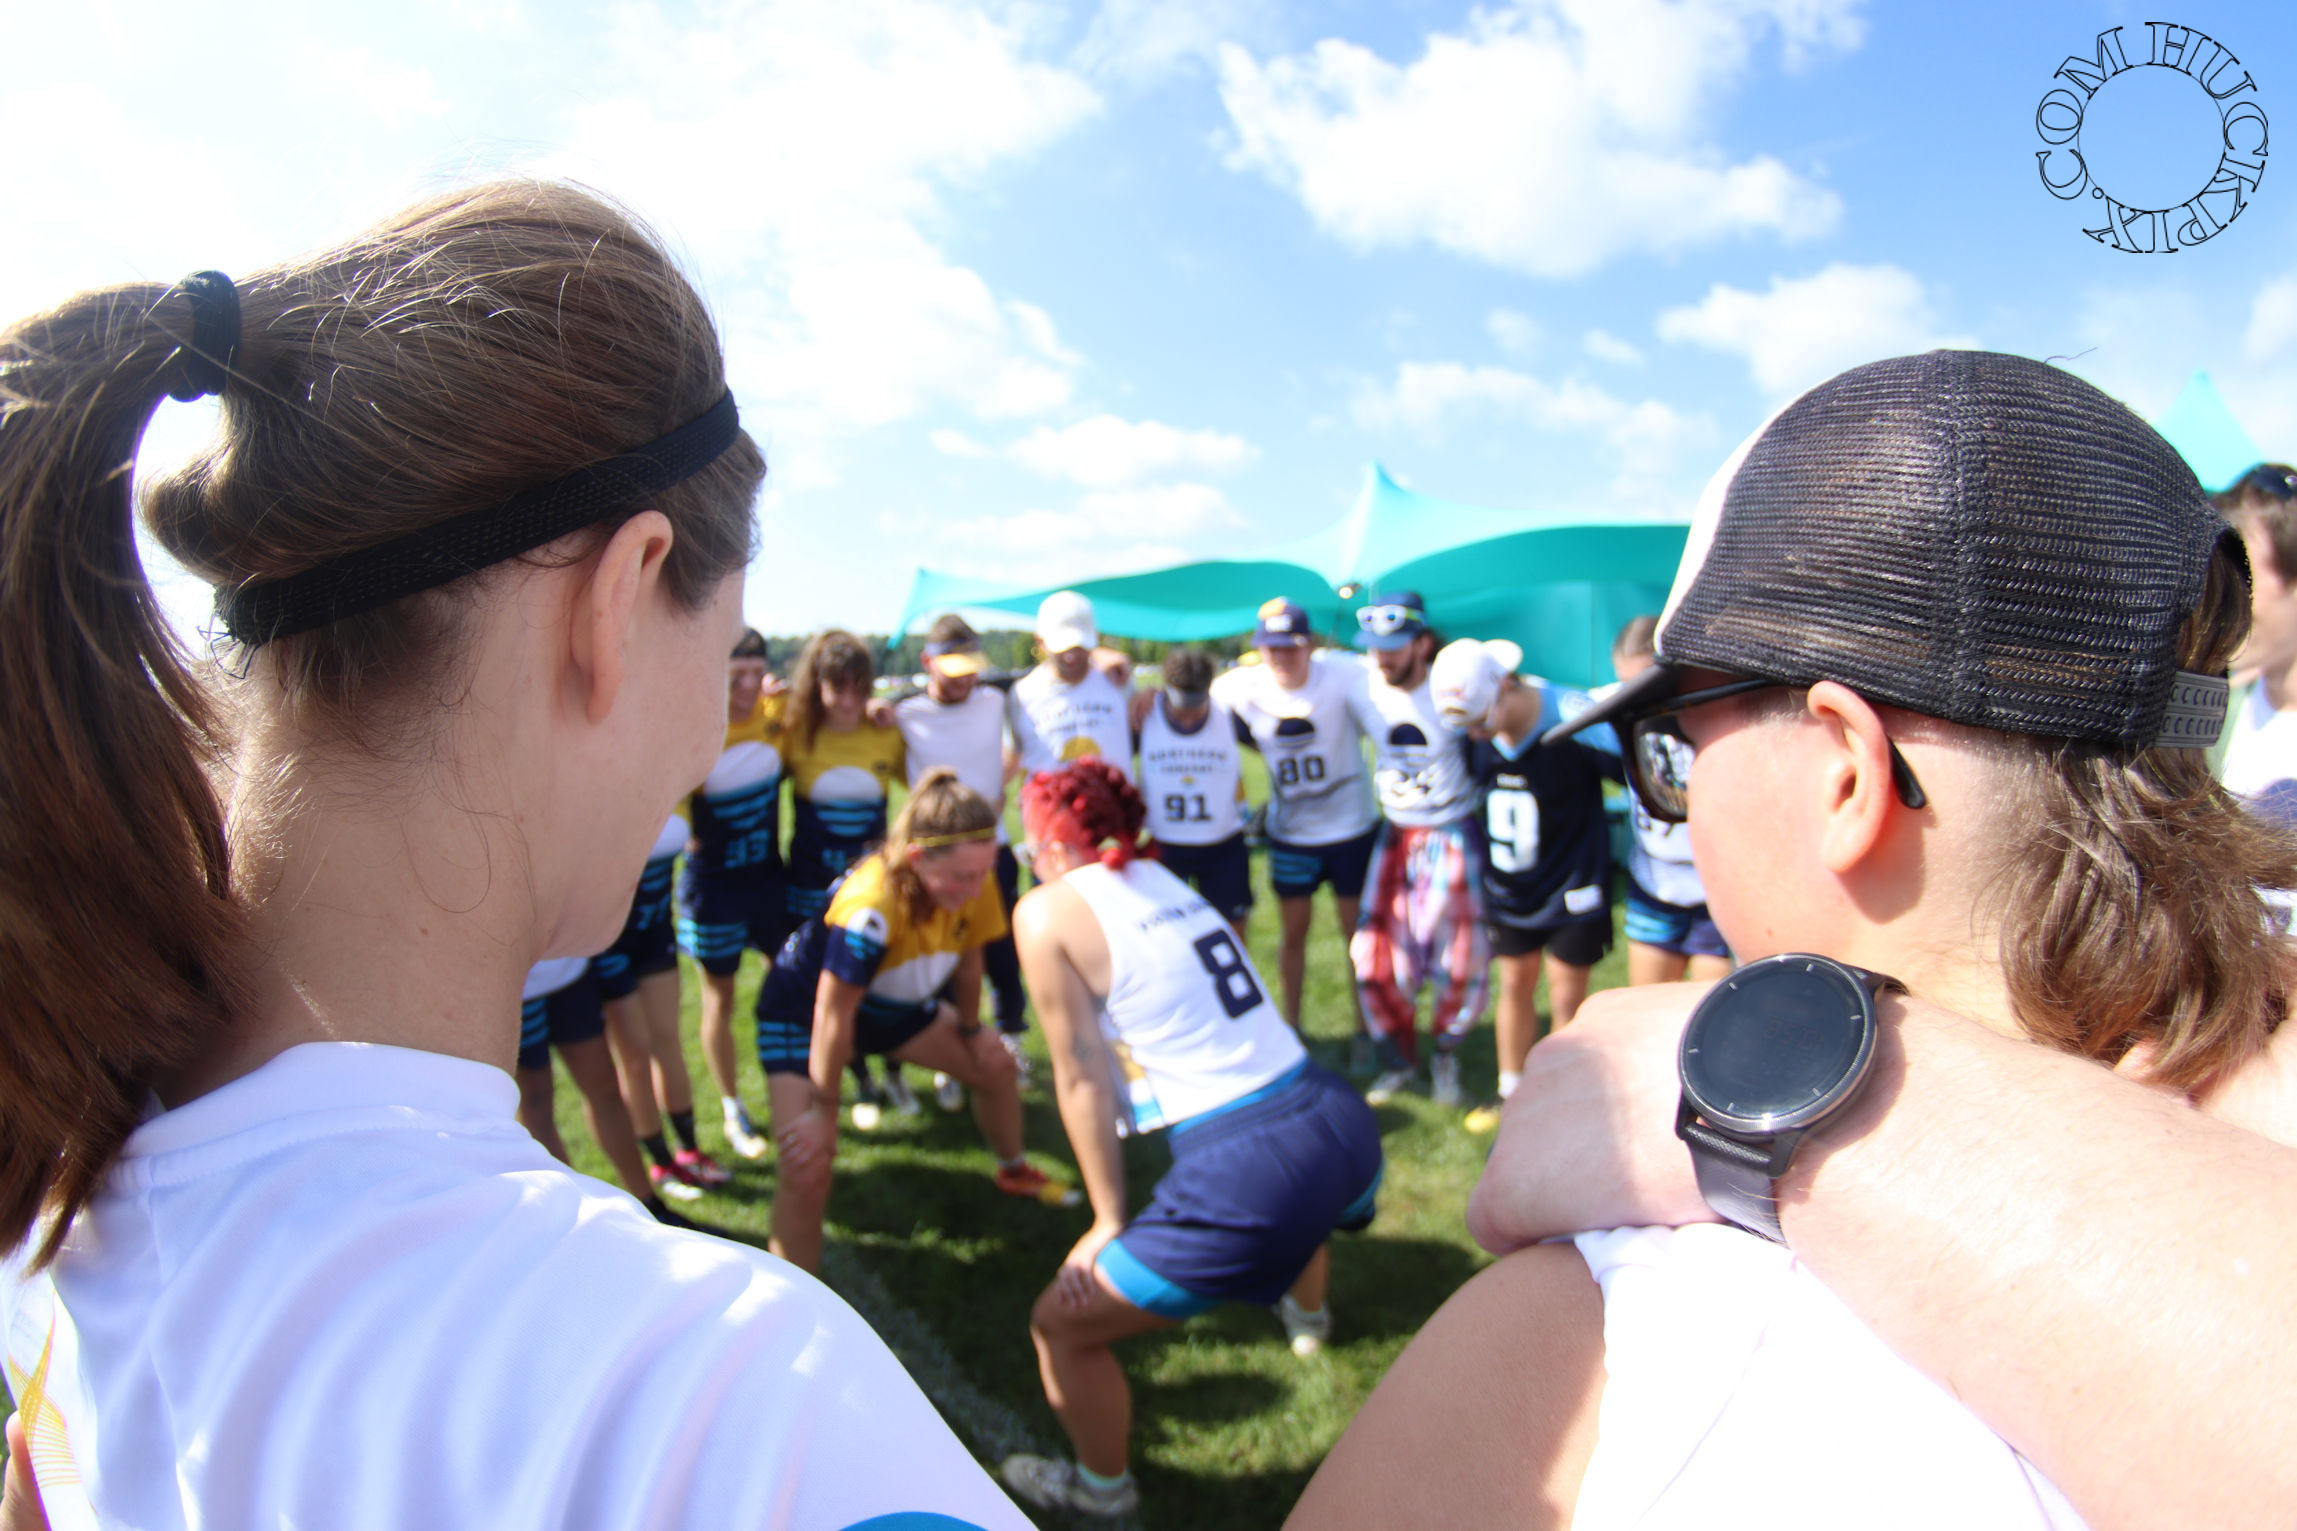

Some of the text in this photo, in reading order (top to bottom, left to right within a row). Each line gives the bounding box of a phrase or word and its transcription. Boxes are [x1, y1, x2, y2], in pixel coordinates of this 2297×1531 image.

[1277, 757, 1325, 785] 80
[1164, 793, 1213, 821] 91
[1486, 790, 1540, 874] 9
[1193, 929, 1264, 1019] 8
